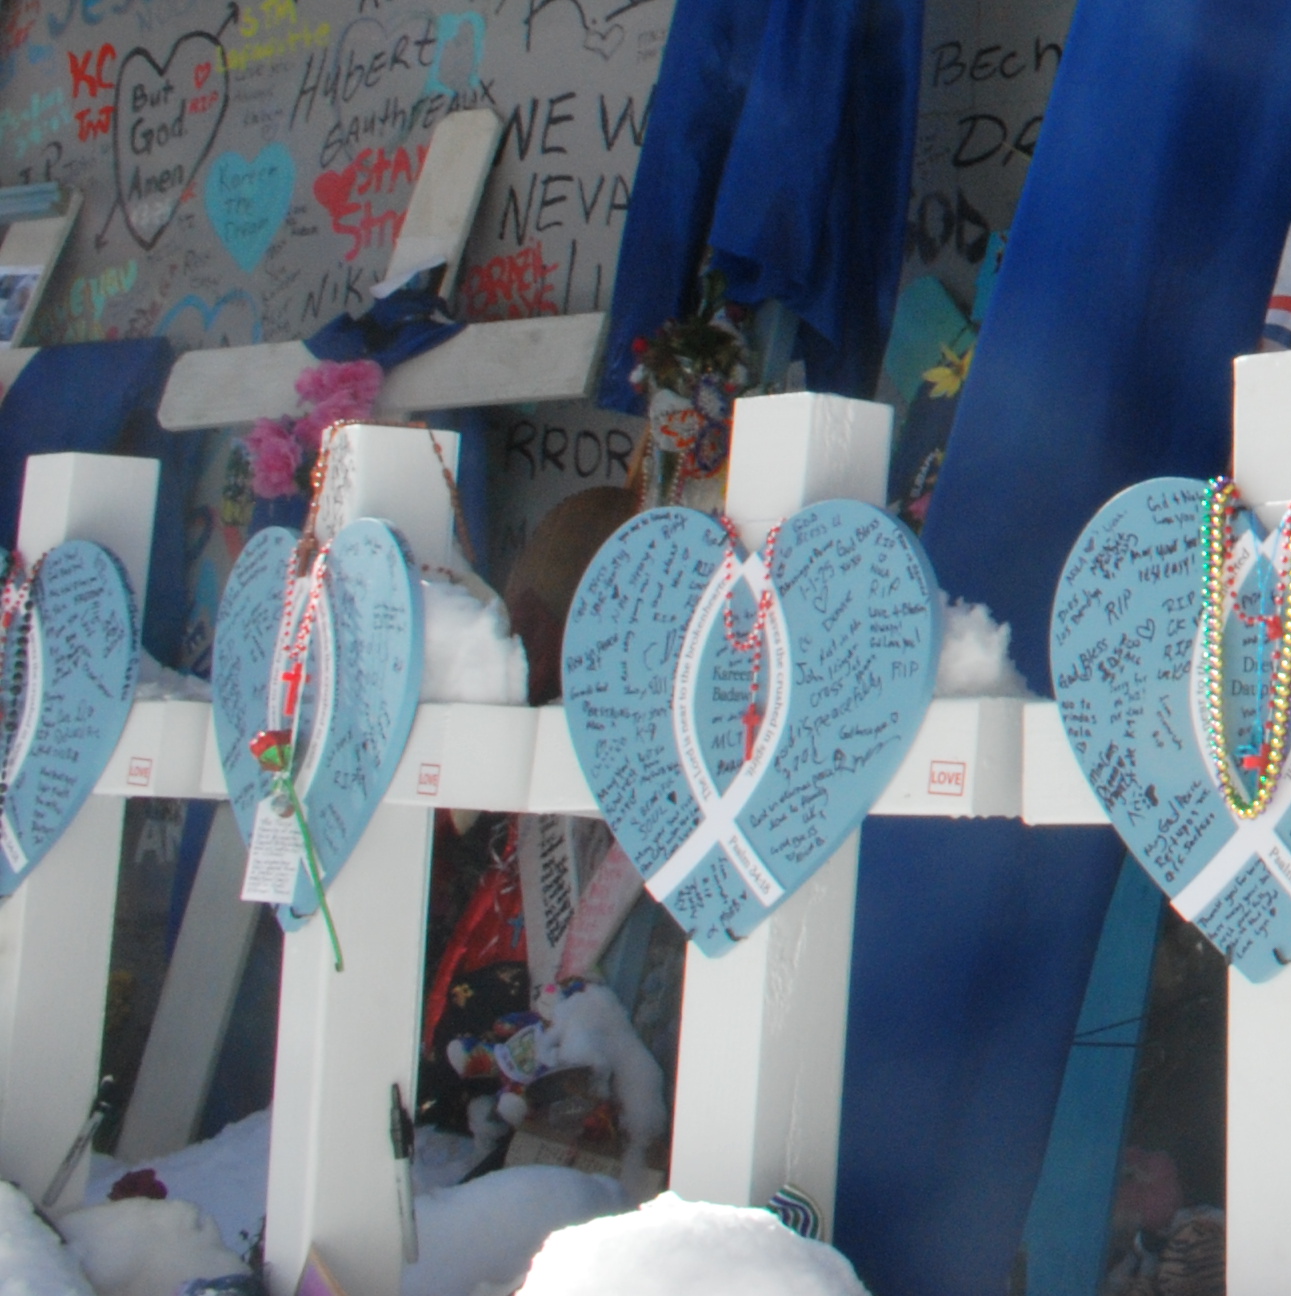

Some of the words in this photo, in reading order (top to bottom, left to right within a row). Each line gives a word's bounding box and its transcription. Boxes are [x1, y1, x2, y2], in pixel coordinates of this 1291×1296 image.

[132, 83, 174, 112] But
[130, 100, 188, 154] God
[930, 771, 962, 786] LOVE
[727, 835, 755, 871] Psalm
[749, 864, 772, 898] 34:18
